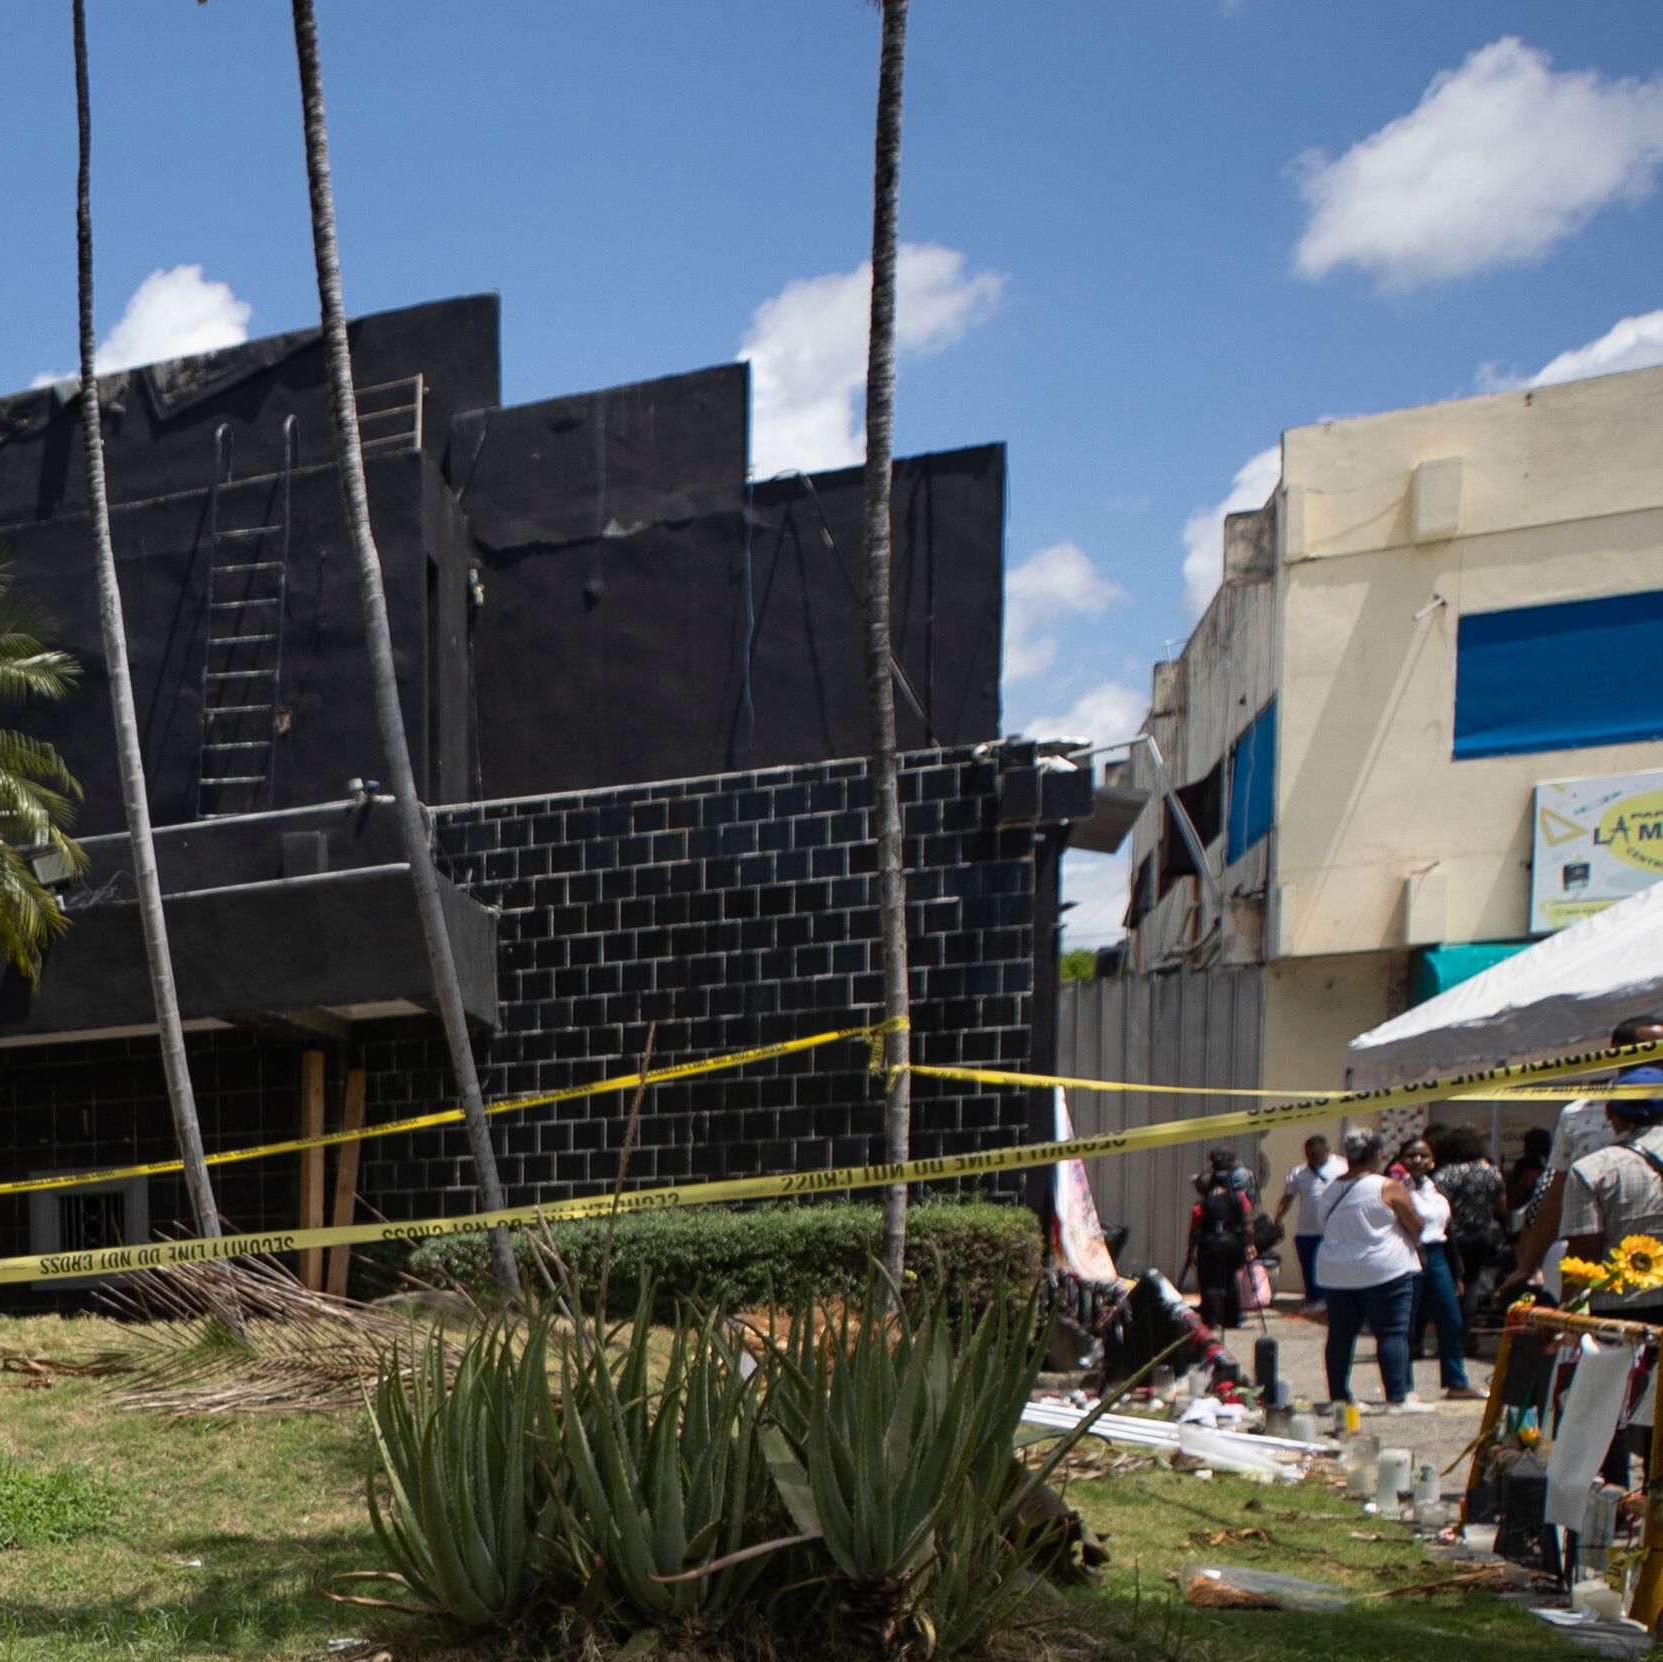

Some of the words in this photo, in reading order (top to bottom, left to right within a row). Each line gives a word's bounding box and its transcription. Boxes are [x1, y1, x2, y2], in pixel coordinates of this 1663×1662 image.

[40, 1255, 94, 1275] CROSS
[100, 1251, 132, 1269] NOT
[137, 1248, 161, 1265] DO
